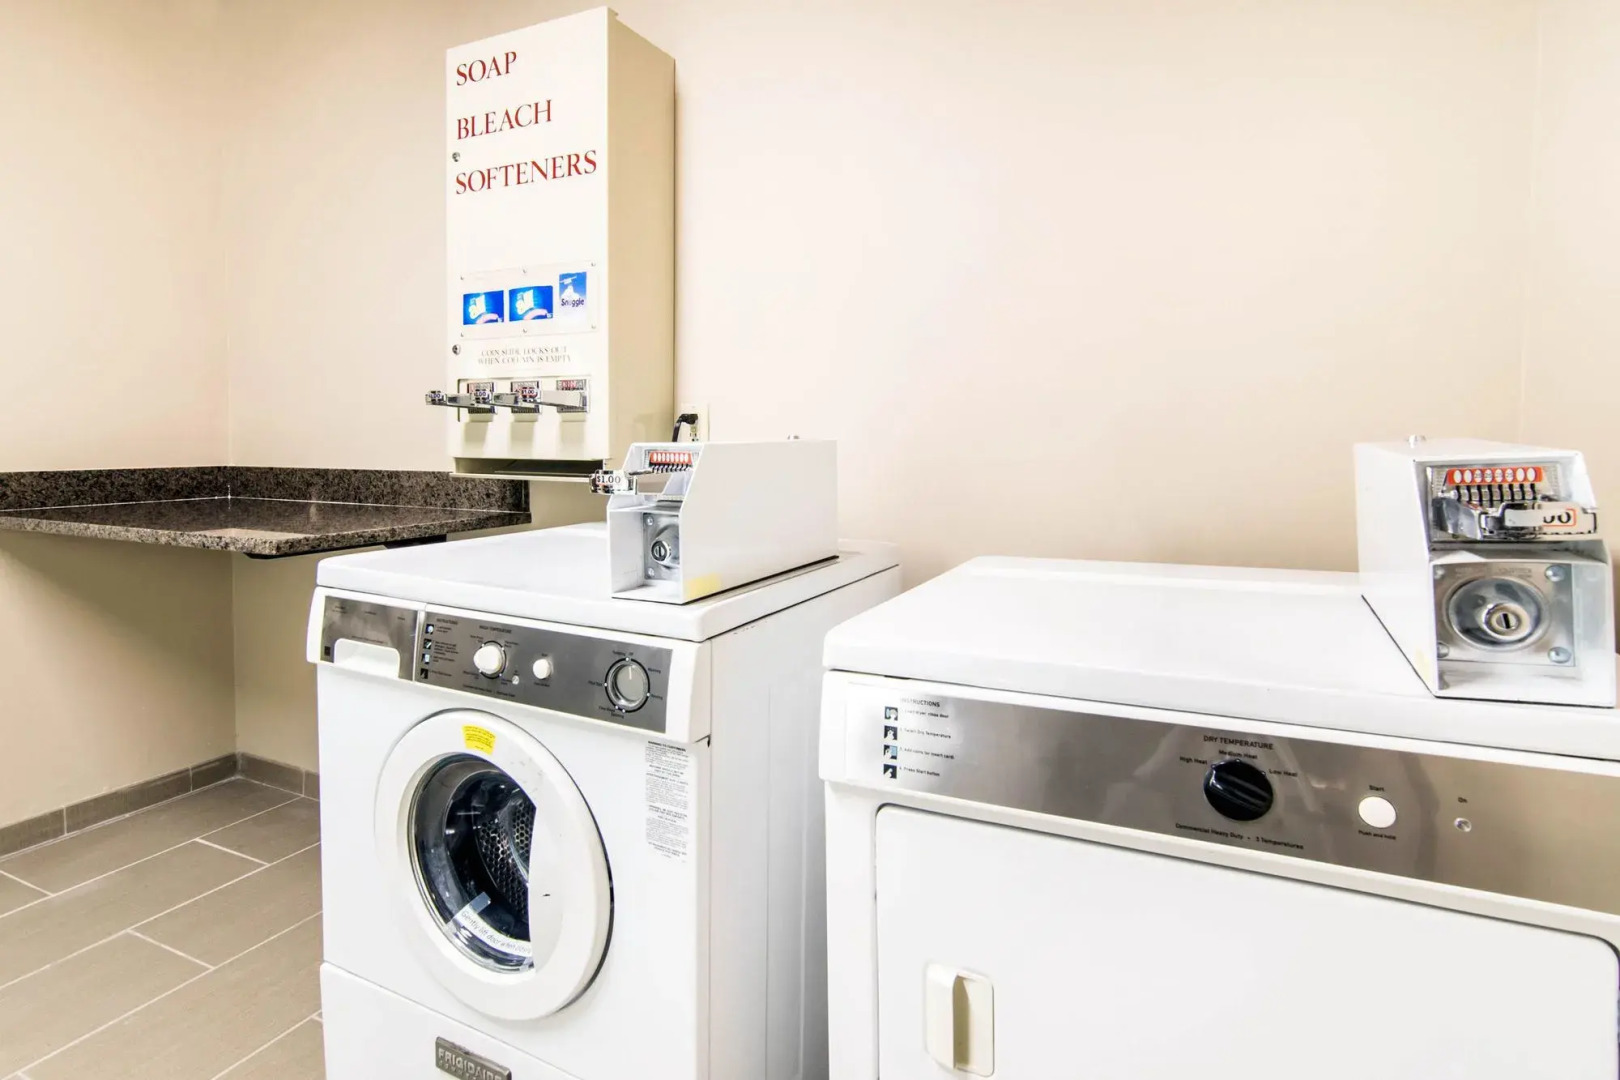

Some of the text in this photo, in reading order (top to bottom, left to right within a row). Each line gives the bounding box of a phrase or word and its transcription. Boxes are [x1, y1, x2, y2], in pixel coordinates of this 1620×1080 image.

[456, 51, 517, 86] SOAP
[457, 99, 552, 140] BLEACH
[455, 149, 597, 195] SOFTENERS
[561, 297, 585, 308] Snggle
[596, 475, 621, 484] $1.00
[1203, 734, 1274, 750] DRY TEMPERATURE
[1179, 756, 1193, 764] High
[1218, 750, 1242, 758] Medium
[1175, 822, 1210, 834] Commercial
[1230, 831, 1244, 840] Duty
[462, 911, 479, 930] Gently
[479, 927, 488, 936] lift
[487, 934, 502, 945] door
